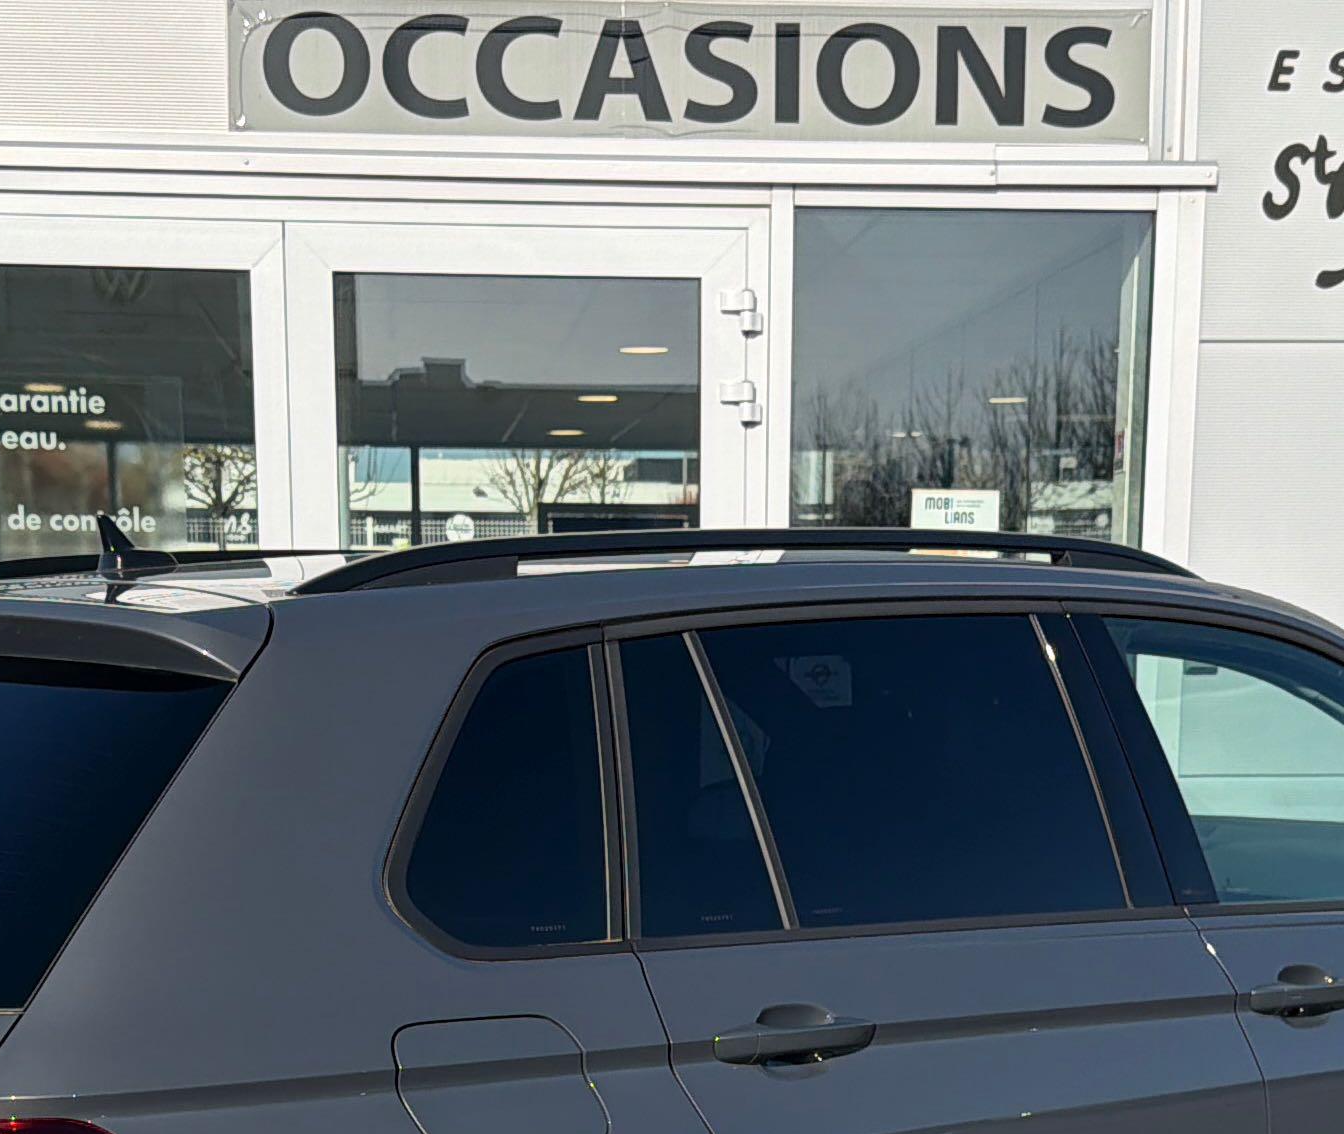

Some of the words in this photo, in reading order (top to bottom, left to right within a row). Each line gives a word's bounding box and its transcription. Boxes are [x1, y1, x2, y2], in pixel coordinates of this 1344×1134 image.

[263, 12, 1116, 127] OCCASIONS
[7, 504, 42, 531] de
[50, 506, 156, 533] conôle
